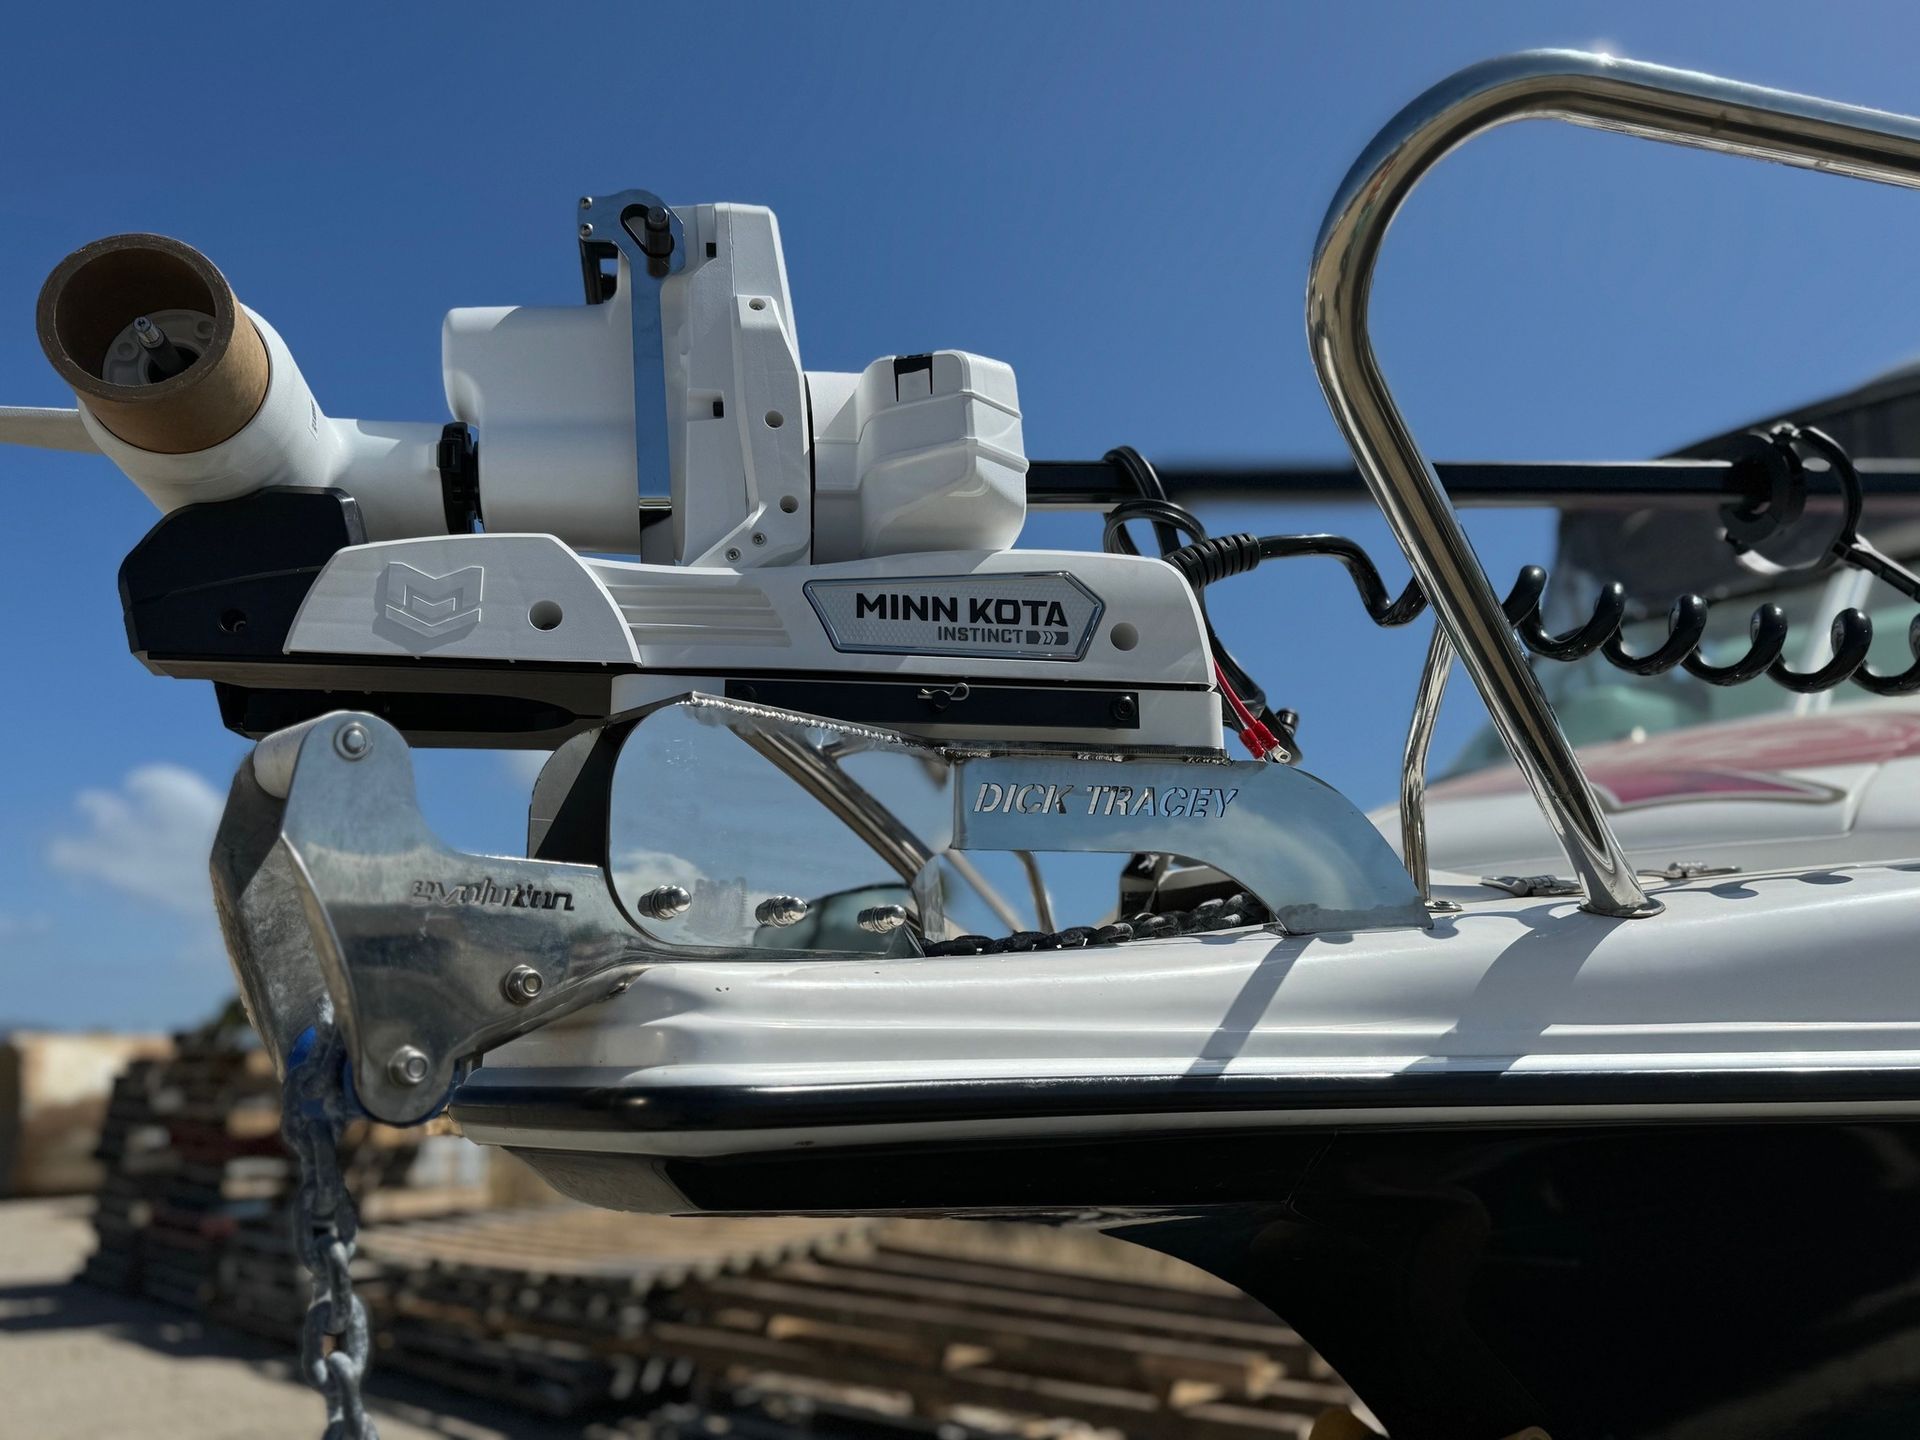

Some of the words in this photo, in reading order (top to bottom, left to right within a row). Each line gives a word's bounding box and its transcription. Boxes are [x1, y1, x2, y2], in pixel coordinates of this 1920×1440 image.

[856, 592, 958, 623] MINN
[969, 598, 1069, 627] KOTA
[937, 626, 1024, 644] INSTINCT
[973, 782, 1074, 815] DICK
[1086, 786, 1239, 818] TRACEY
